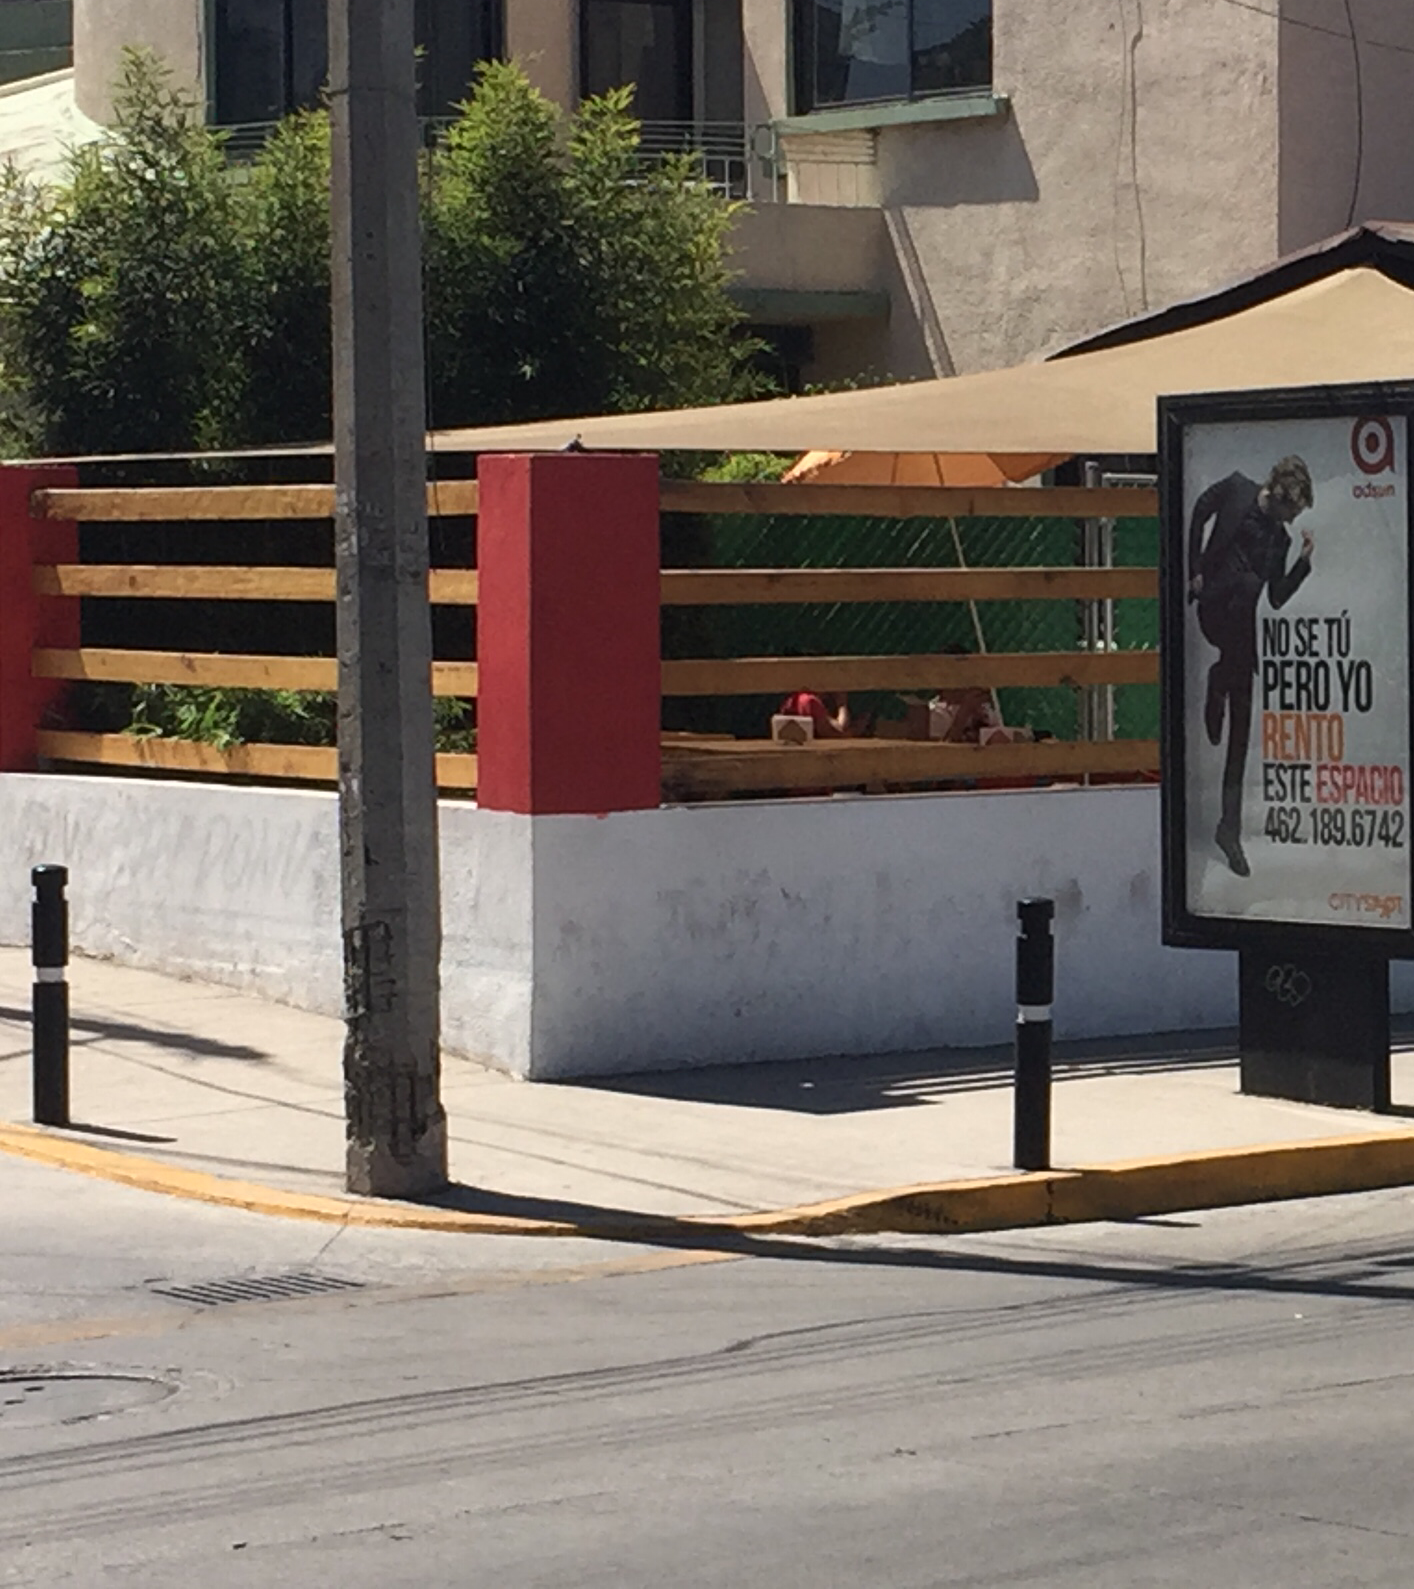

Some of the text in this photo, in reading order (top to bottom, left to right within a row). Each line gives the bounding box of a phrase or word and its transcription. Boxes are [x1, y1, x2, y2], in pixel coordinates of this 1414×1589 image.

[1262, 610, 1350, 659] NO SE TÚ
[1262, 660, 1373, 713] PERO YO
[1262, 713, 1344, 762] RENTO
[1263, 763, 1404, 806] ESTE ESPACIO
[1264, 806, 1404, 848] 462.189.6742
